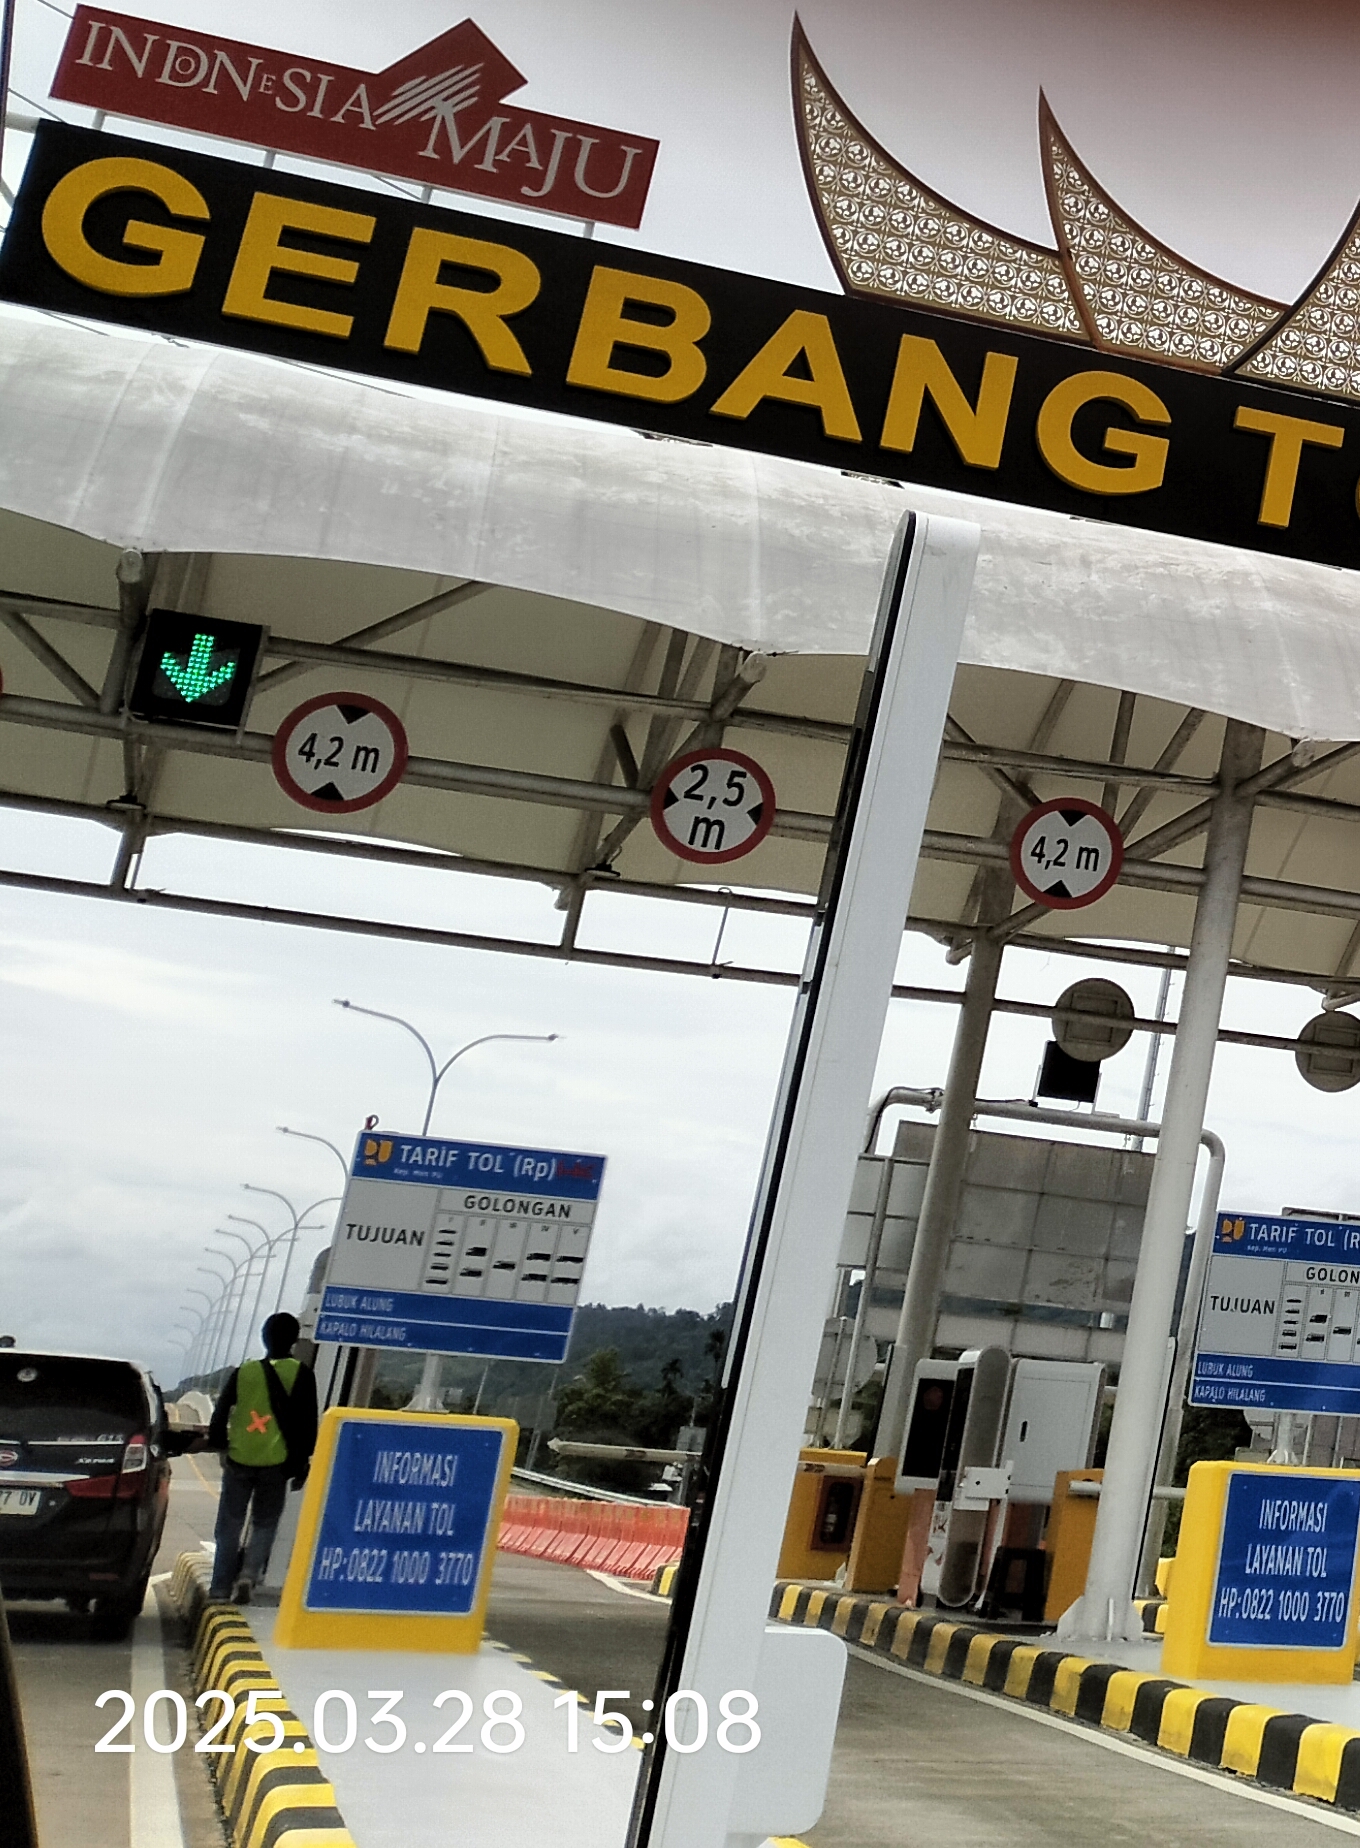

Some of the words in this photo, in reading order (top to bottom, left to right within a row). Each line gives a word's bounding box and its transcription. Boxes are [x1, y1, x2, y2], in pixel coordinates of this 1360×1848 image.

[75, 20, 377, 131] INDONESIA
[418, 101, 642, 198] MAJU
[41, 156, 1171, 496] GERBANG
[298, 732, 344, 770] 4,2
[351, 745, 379, 773] m
[683, 763, 747, 810] 2,5
[688, 815, 725, 850] m
[1030, 835, 1069, 870] 4,2
[1075, 845, 1100, 872] m
[400, 1143, 459, 1168] TARIF
[467, 1151, 504, 1173] TOL
[513, 1154, 557, 1181] (Rp)
[464, 1194, 572, 1219] GOLONGAN
[346, 1223, 426, 1247] TUJUAN
[1250, 1223, 1296, 1243] TARIF
[1305, 1228, 1335, 1247] TOL
[325, 1293, 359, 1309] LUBUK
[359, 1296, 394, 1312] ALUNG
[1210, 1295, 1275, 1315] TUJUAN
[320, 1321, 358, 1337] KAPALO
[1197, 1361, 1225, 1376] LUBUK
[1226, 1363, 1253, 1378] ALUNG
[1194, 1385, 1225, 1400] KAPALO
[1227, 1387, 1266, 1402] HILALANG
[373, 1451, 459, 1487] INFORMASI
[353, 1500, 427, 1534] LAYANAN
[428, 1502, 455, 1536] TOL
[1259, 1498, 1328, 1533] INFORMASI
[318, 1547, 387, 1583] HP:0822
[391, 1550, 430, 1585] 1000
[435, 1552, 473, 1586] 3770
[1245, 1543, 1304, 1576] LAYANAN
[1305, 1547, 1327, 1578] TOL
[1218, 1588, 1274, 1621] HP:0822
[1278, 1589, 1309, 1622] 1000
[1313, 1591, 1345, 1623] 3770
